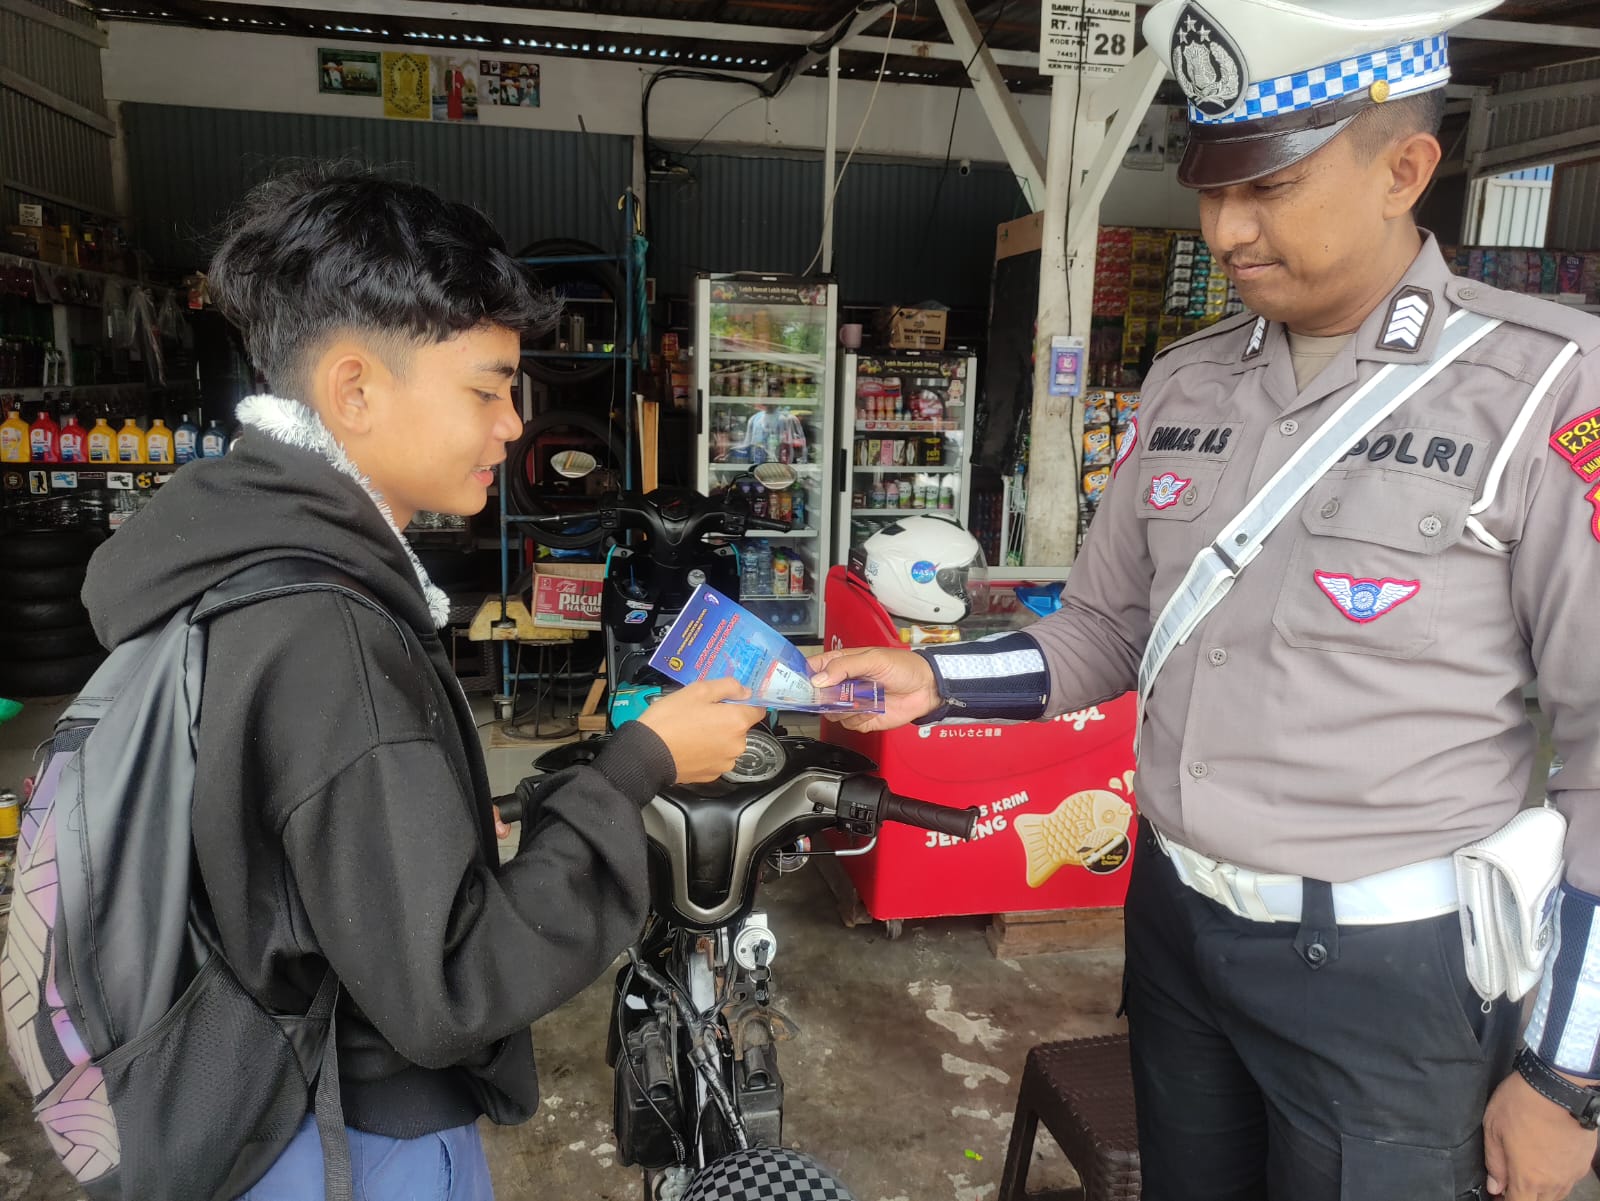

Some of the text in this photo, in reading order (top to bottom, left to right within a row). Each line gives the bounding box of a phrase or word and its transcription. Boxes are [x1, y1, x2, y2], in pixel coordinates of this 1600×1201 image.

[1051, 19, 1070, 30] RT.
[1094, 33, 1126, 56] 28
[1557, 417, 1600, 446] POL
[1338, 432, 1474, 477] POLRI
[912, 568, 935, 577] NASA
[991, 791, 1029, 813] KRIM
[925, 815, 1008, 848] JENG
